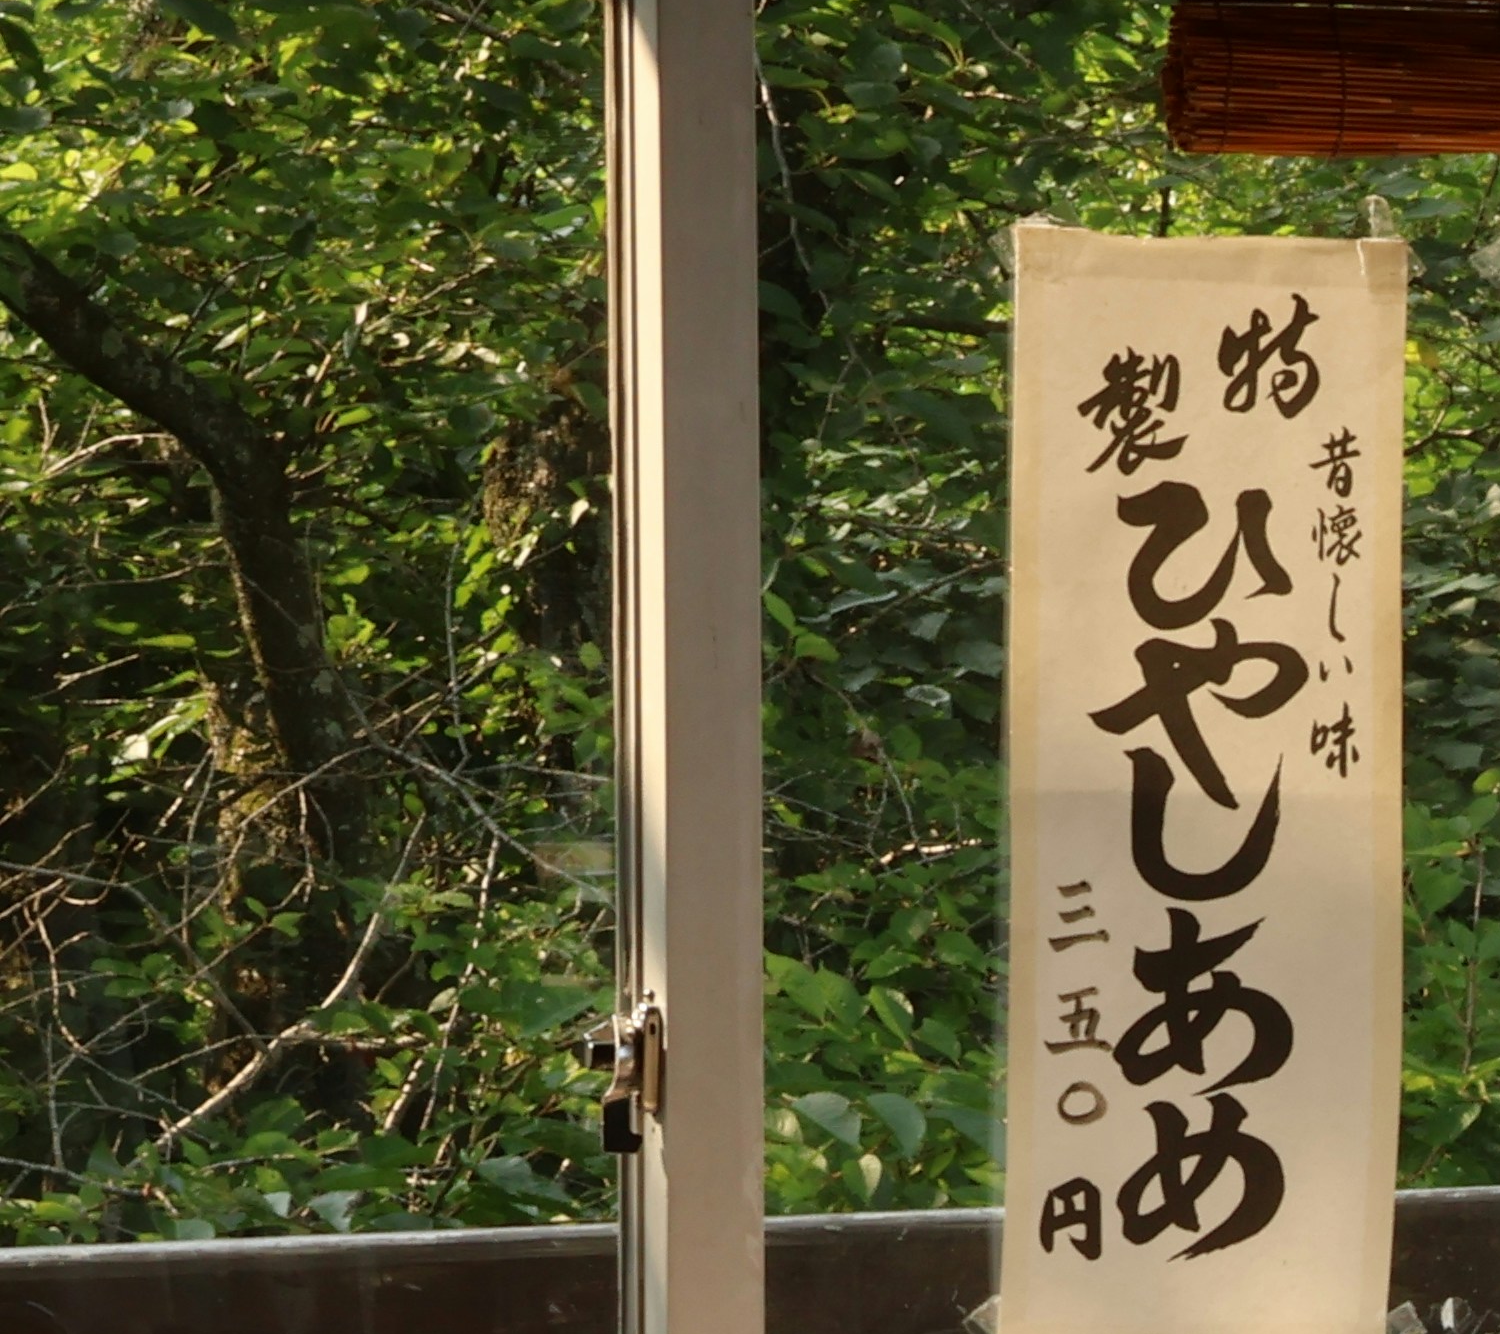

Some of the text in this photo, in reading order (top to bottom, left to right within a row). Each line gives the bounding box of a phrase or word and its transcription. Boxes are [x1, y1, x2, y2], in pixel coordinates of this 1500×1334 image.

[1087, 480, 1311, 1262] ひやしあめ
